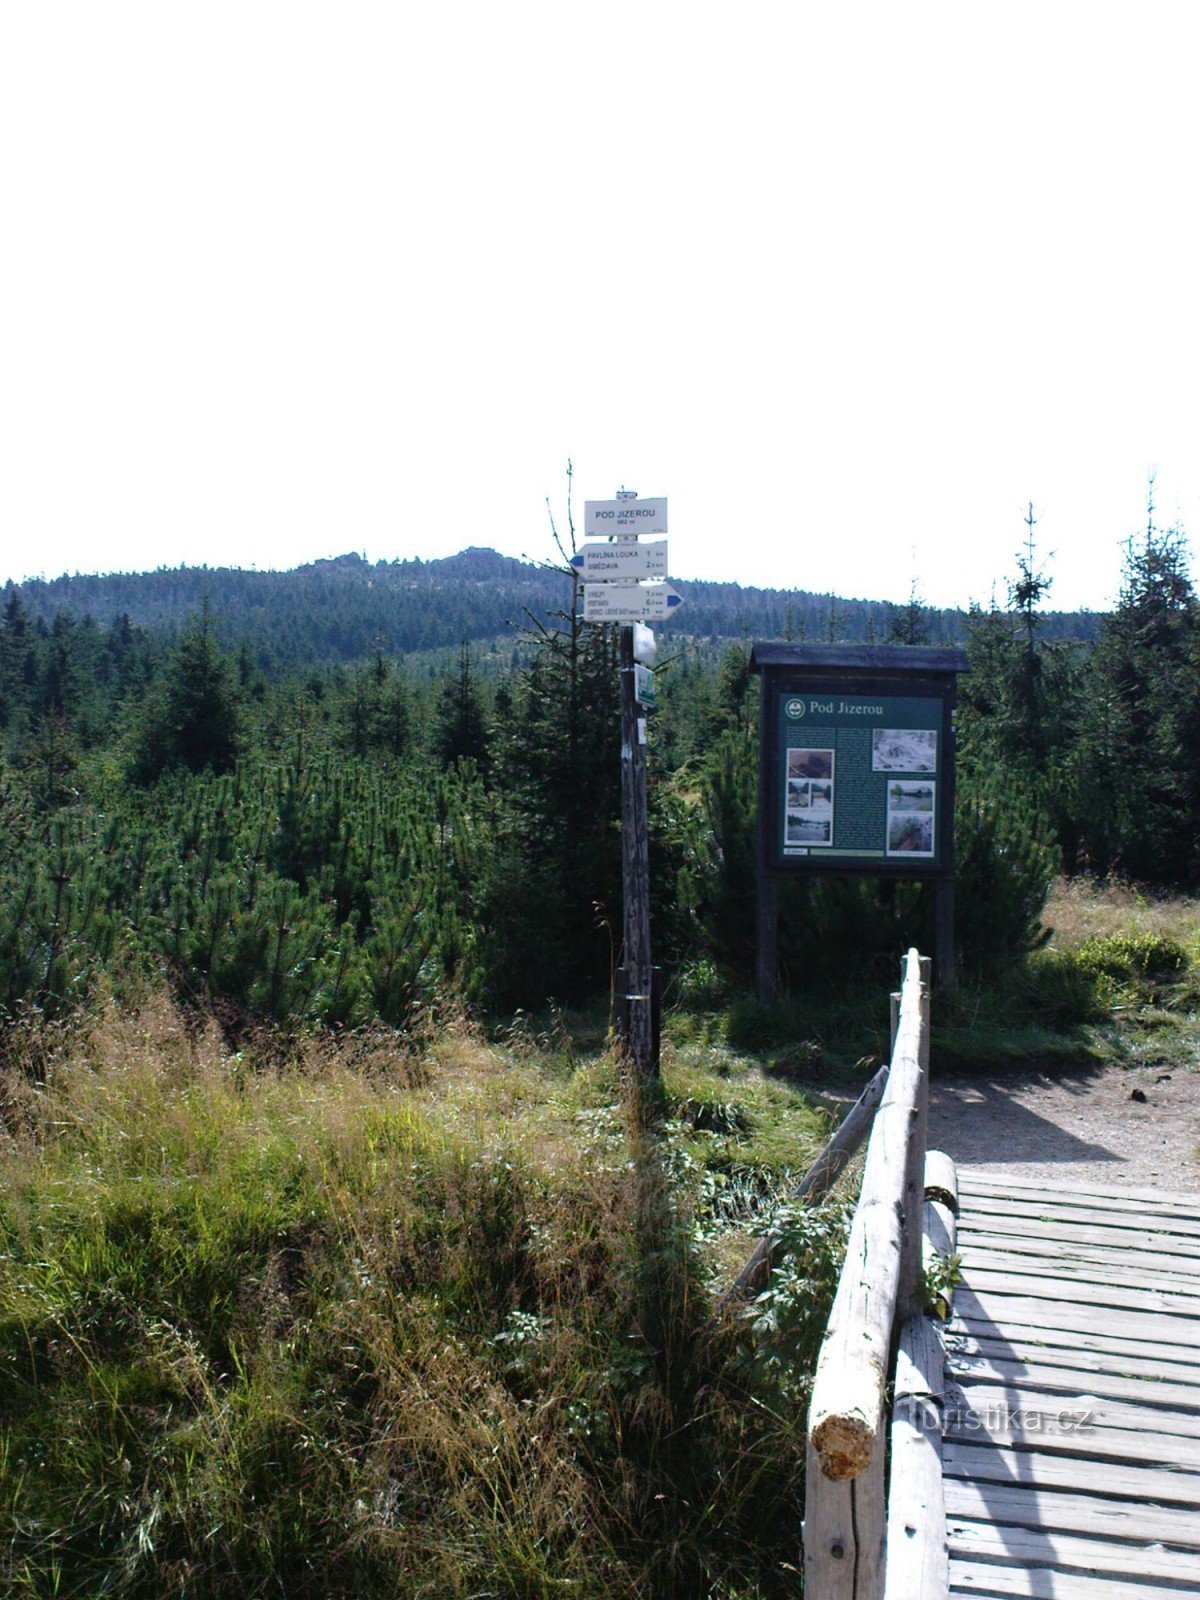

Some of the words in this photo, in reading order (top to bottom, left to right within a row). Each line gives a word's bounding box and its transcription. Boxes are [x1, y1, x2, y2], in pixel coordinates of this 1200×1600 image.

[617, 509, 655, 517] JIZEROU
[810, 701, 833, 713] Pod
[838, 702, 883, 715] Jizerou
